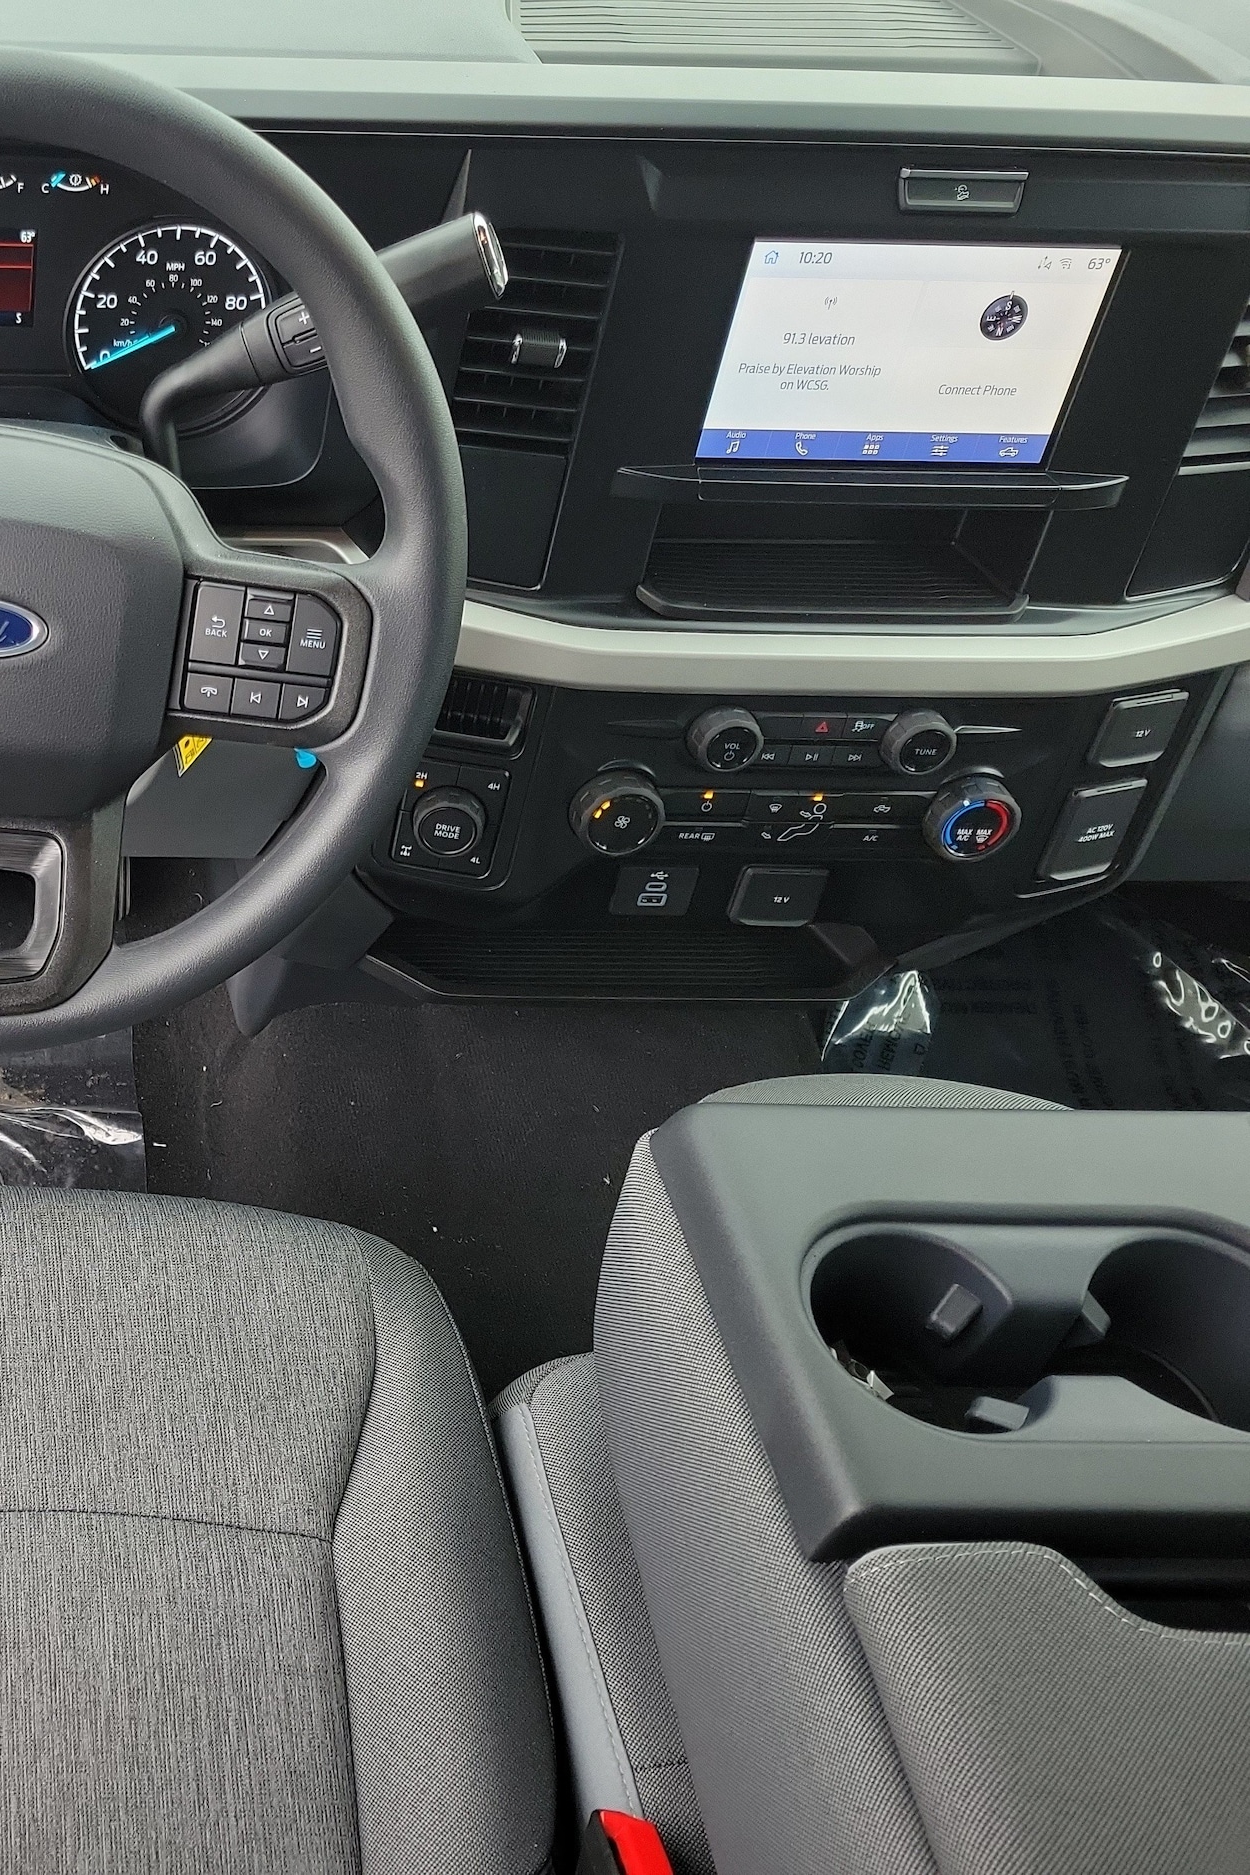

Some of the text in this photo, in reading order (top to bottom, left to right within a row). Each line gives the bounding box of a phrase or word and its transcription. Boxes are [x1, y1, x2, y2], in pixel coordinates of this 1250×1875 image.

[17, 182, 25, 193] F
[41, 183, 50, 194] C
[100, 184, 109, 194] H
[136, 251, 158, 265] 40
[194, 252, 217, 266] 60
[798, 251, 833, 265] 10:20
[166, 263, 185, 272] MPH
[1087, 257, 1112, 271] 63°
[145, 279, 156, 288] 60
[169, 274, 179, 283] 80
[190, 279, 203, 287] 100
[96, 294, 118, 309] 20
[128, 296, 137, 304] 40
[207, 295, 218, 304] 120
[224, 296, 247, 311] 80
[1005, 300, 1013, 311] S
[15, 313, 22, 324] S
[120, 318, 129, 327] 20
[211, 318, 223, 327] 140
[783, 332, 856, 346] 91.3 levation
[738, 362, 882, 378] Praise by Elevation Worship
[780, 380, 830, 391] on WCSG.
[938, 384, 1018, 397] Connect Phone
[726, 431, 746, 440] Audio
[795, 432, 817, 441] Phone
[865, 433, 884, 442] Apps
[930, 434, 959, 444] Settings
[999, 435, 1029, 444] Features
[205, 628, 228, 638] BACK
[259, 628, 272, 637] OK
[300, 639, 326, 650] MENU
[1135, 729, 1152, 738] 12 V
[724, 742, 741, 750] VOL
[914, 748, 938, 756] TUNE
[415, 771, 428, 780] 2H
[487, 782, 501, 791] 4H
[436, 823, 461, 834] DRIVE
[956, 828, 973, 836] MAX
[1087, 823, 1113, 835] AC 120V
[434, 830, 460, 840] MODE
[678, 832, 701, 840] REAR
[1078, 830, 1115, 842] 400W MAX
[470, 856, 481, 864] 4L
